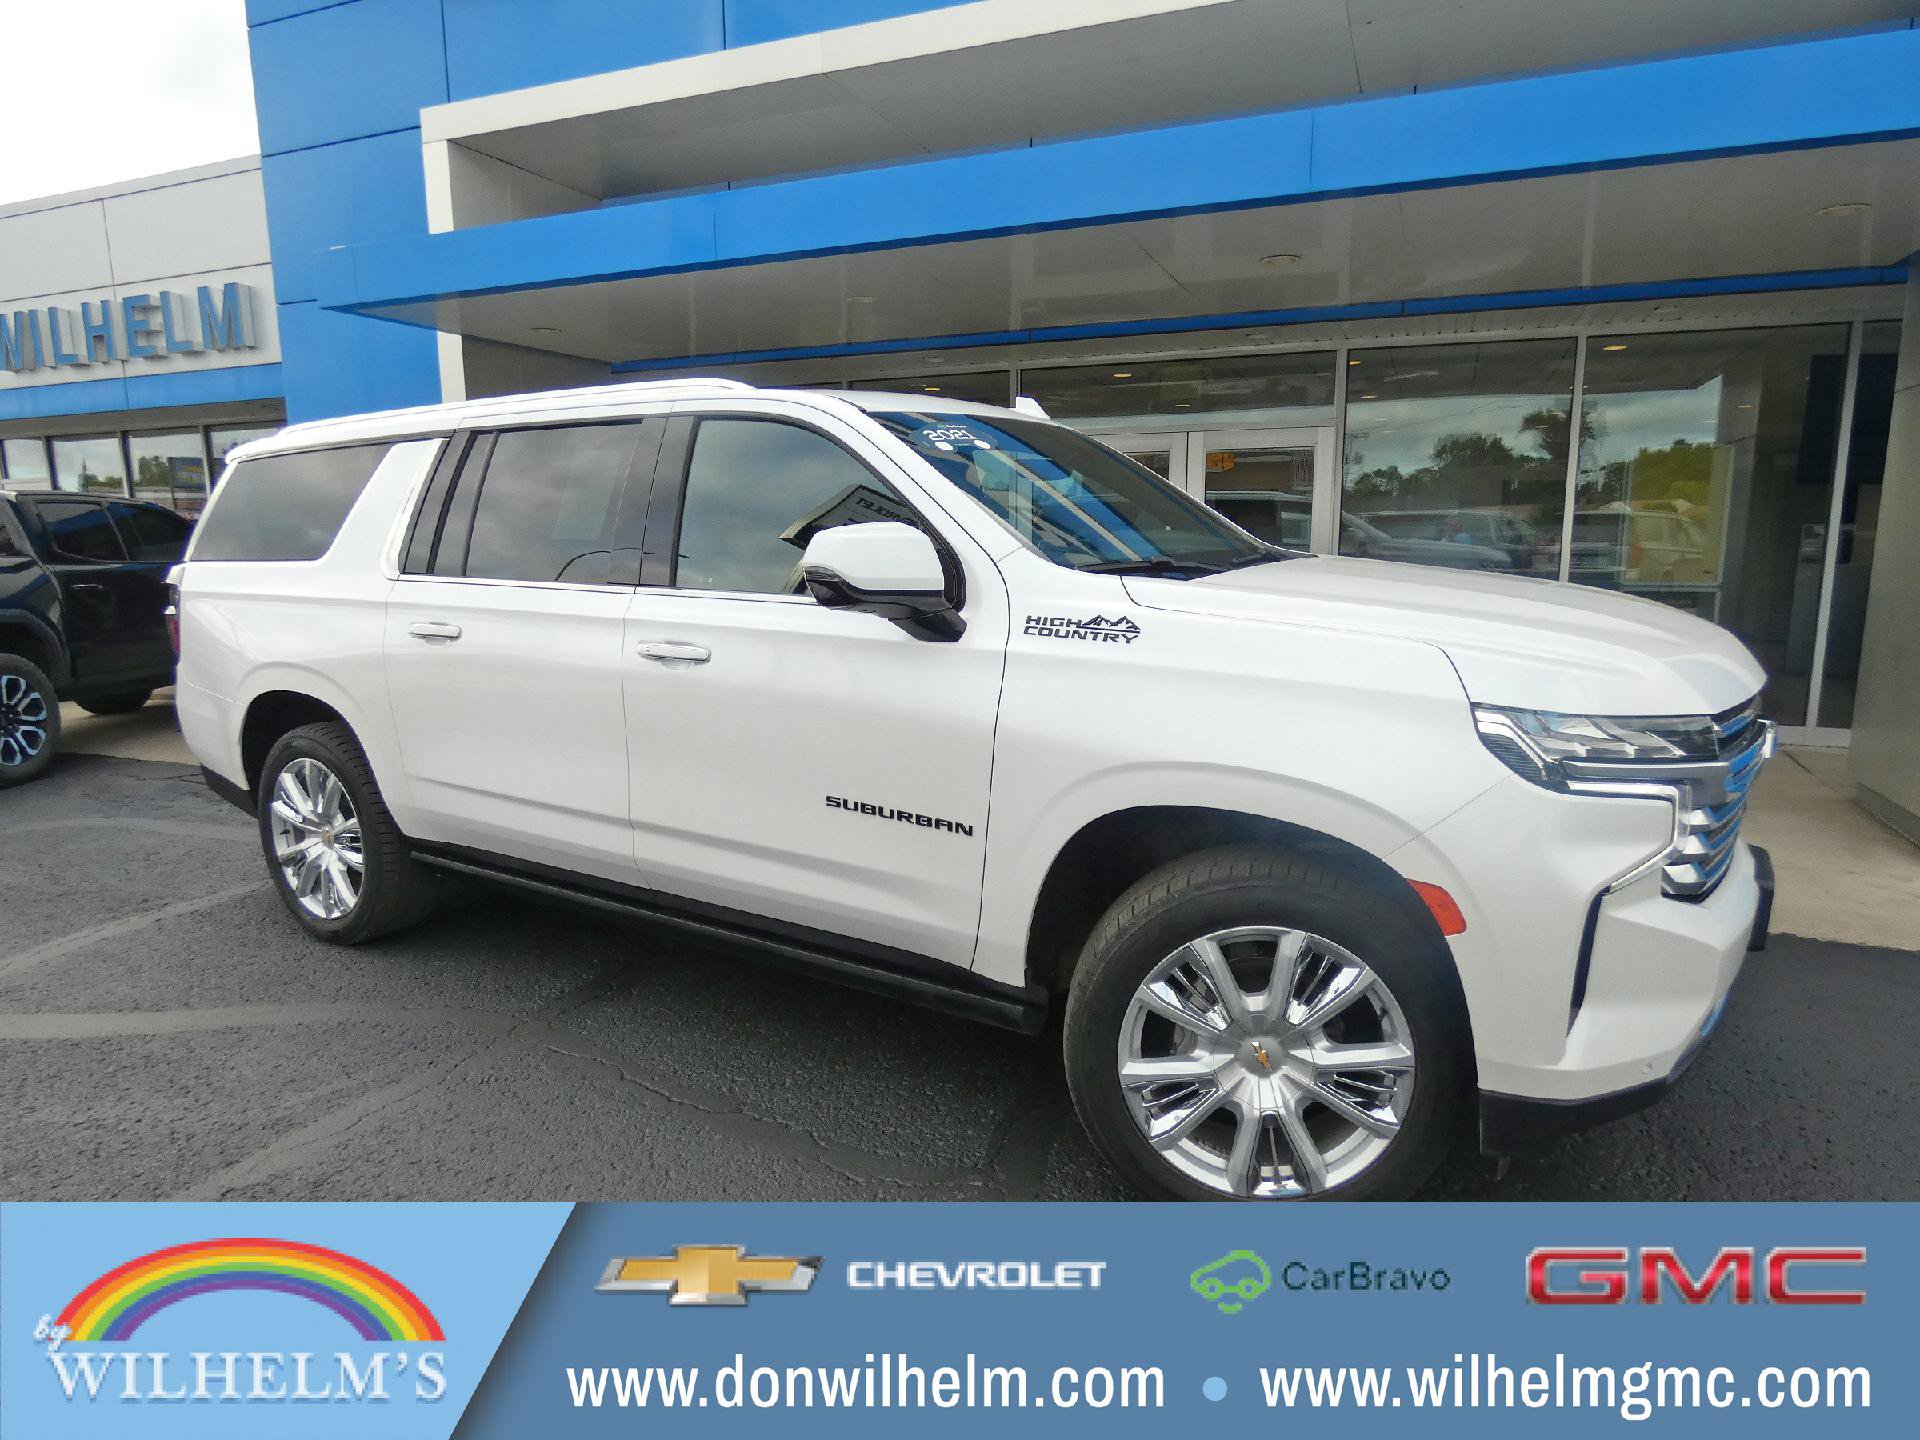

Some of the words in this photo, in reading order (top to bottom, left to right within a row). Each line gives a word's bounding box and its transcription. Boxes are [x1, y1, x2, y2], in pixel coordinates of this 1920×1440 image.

[1025, 615, 1082, 628] HIGH
[1024, 625, 1139, 644] COUNTRY
[825, 795, 974, 837] SUBURBAN
